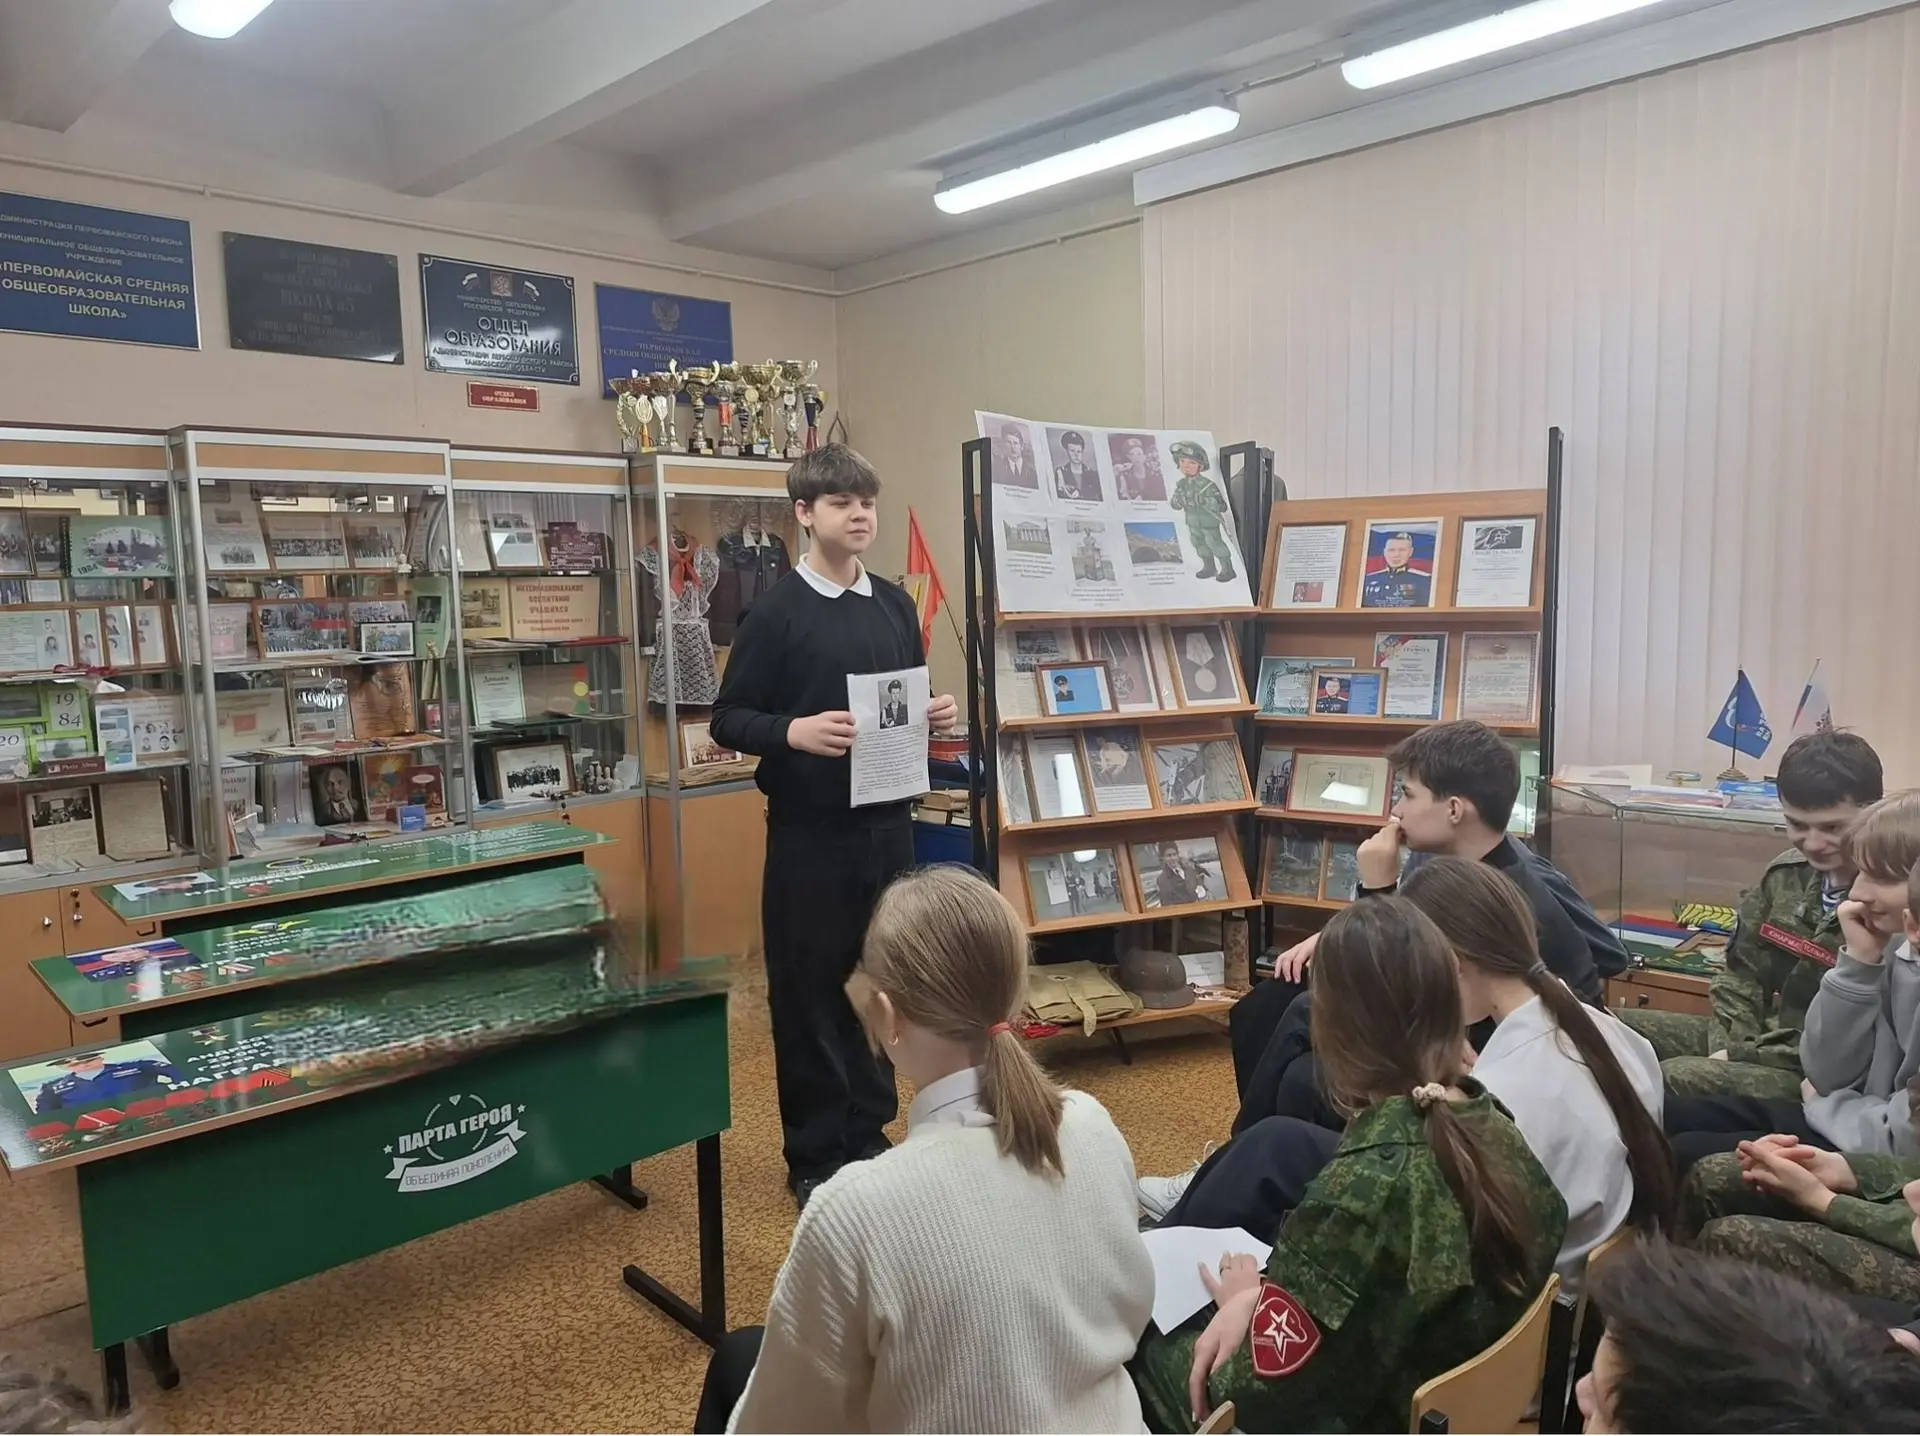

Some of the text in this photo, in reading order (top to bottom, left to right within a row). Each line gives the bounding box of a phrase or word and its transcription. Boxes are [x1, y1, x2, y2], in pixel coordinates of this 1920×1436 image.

[0, 214, 73, 230] ДМИНИСТРАЦИЯ
[151, 235, 183, 246] РАЙОНА
[65, 252, 122, 266] УЧРЕЖДЕНИЕ
[2, 278, 186, 310] ОБЩЕОБРАЗОВАТЕЛЬНАЯ
[126, 277, 189, 294] СРЕДНЯЯ
[68, 303, 127, 319] ШКОЛА»
[478, 316, 529, 336] ОТДЕЛ
[445, 329, 561, 356] ОБРАЗОВАНИЯ
[55, 692, 75, 706] 19
[58, 712, 81, 728] 84
[167, 1058, 288, 1091] НАГРАД
[398, 1103, 512, 1154] ПАРТА ГЕРОЯ
[405, 1143, 511, 1186] ОБЪЕДИНЯЯ ПОКОЛЕНИЯ
